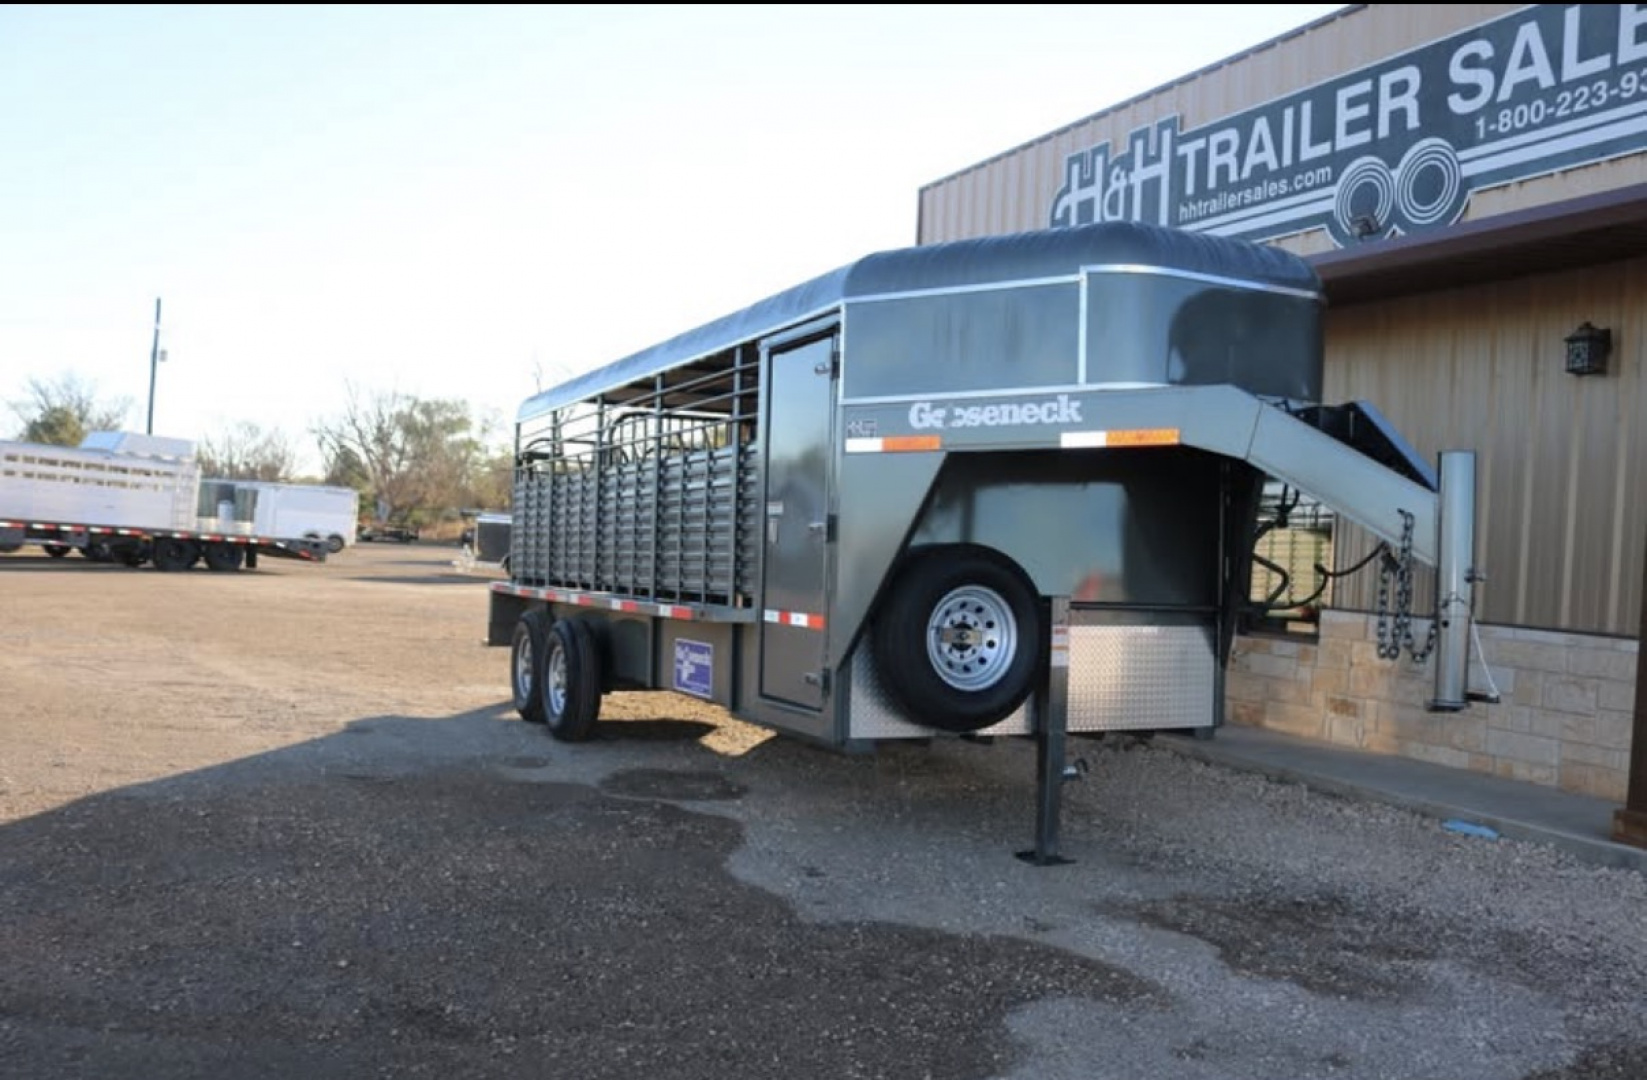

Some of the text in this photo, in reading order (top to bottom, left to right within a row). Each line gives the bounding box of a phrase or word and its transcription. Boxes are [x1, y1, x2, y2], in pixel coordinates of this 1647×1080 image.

[1055, 4, 1647, 226] H&H TRAILER SALE
[1179, 166, 1332, 223] hhtrailersales.com
